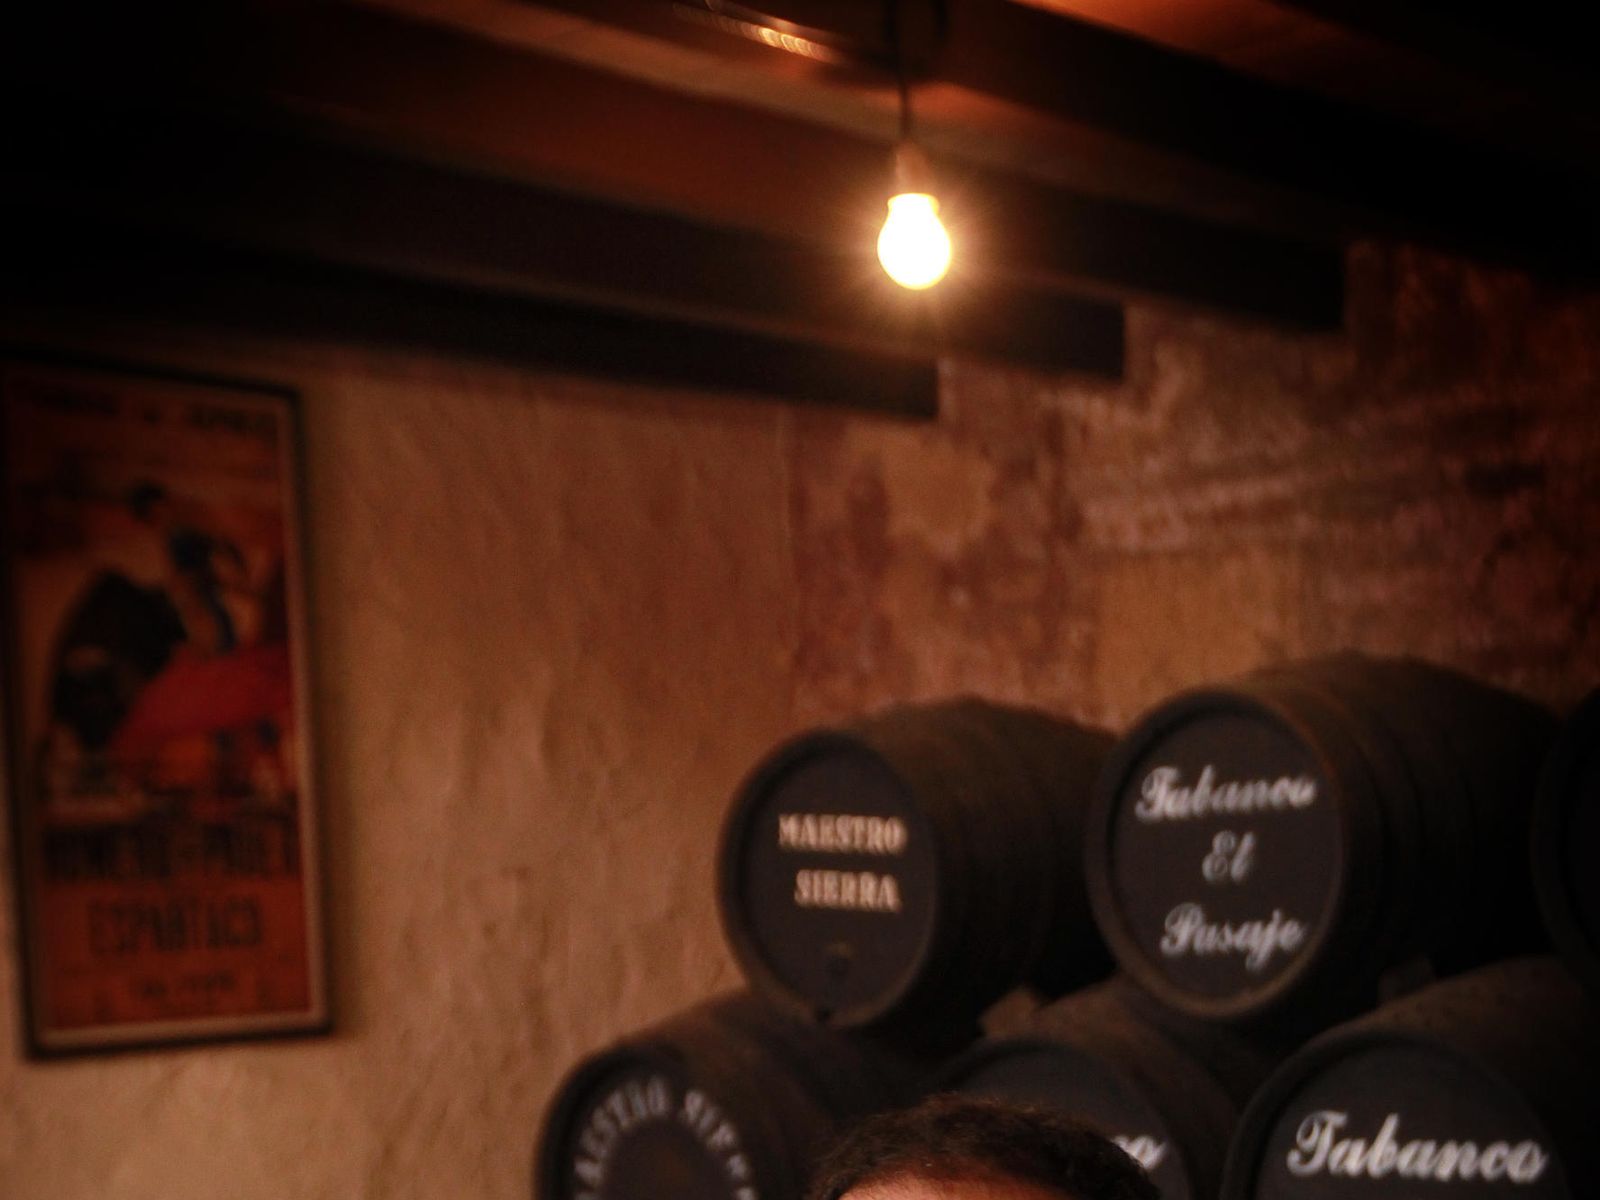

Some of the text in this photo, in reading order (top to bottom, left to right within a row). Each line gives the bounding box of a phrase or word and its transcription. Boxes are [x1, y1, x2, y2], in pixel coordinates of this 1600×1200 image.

[778, 812, 908, 855] MAESTRO
[1202, 830, 1255, 882] El
[794, 868, 902, 912] SIERRA
[1287, 1109, 1550, 1183] Tabanco
